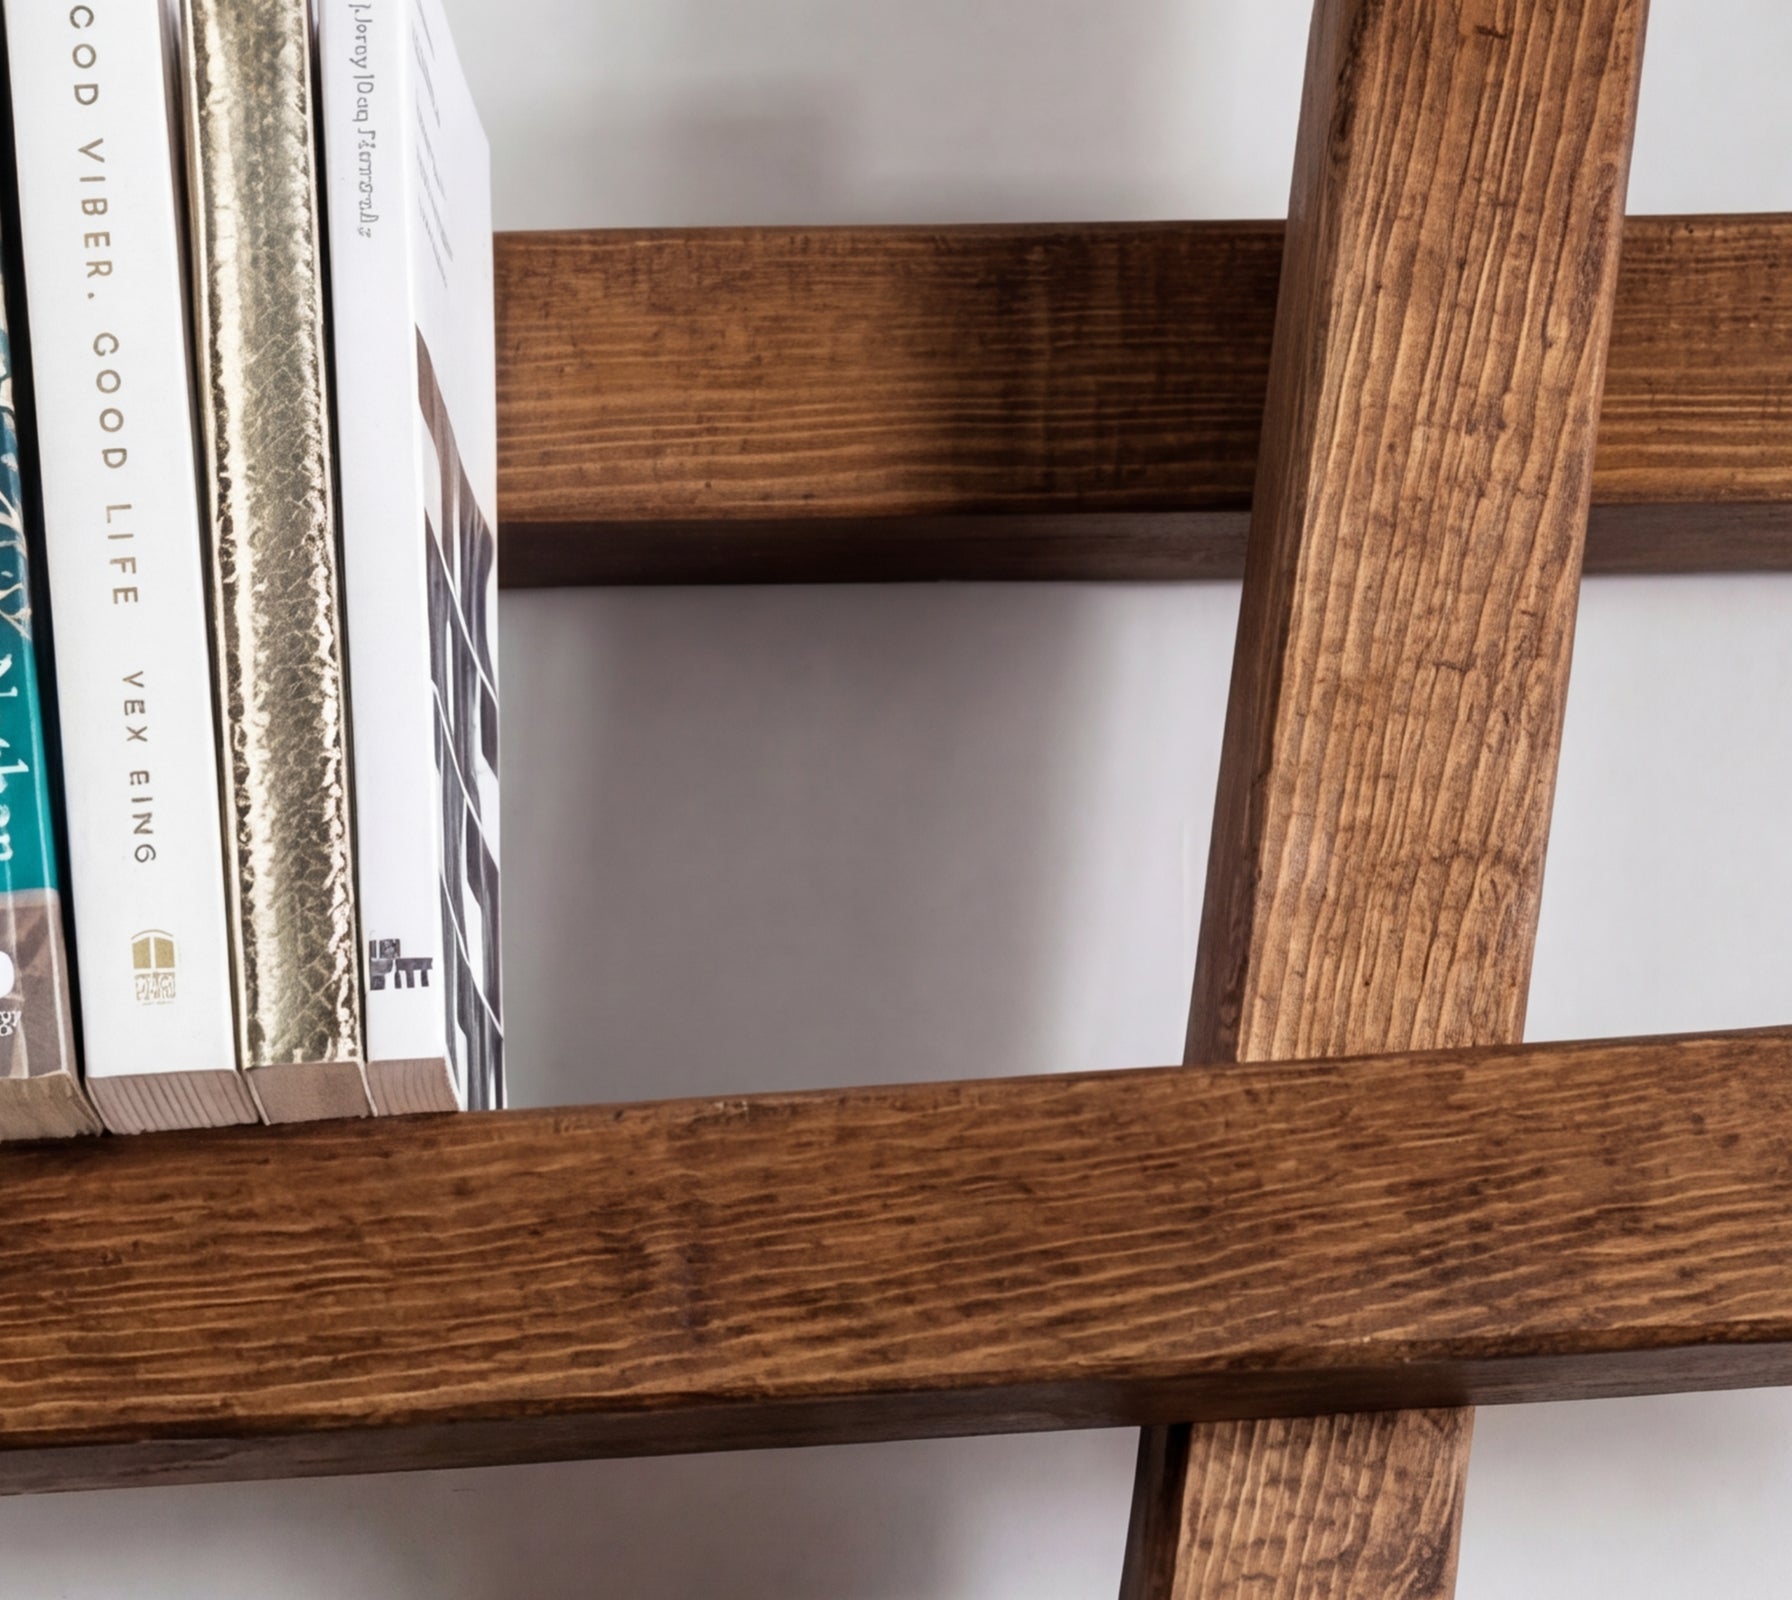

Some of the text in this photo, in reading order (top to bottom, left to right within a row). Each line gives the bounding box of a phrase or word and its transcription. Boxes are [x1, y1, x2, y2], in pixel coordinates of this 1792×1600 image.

[92, 331, 128, 470] GOOD
[105, 503, 139, 606] LIFE
[122, 670, 148, 742] VEX
